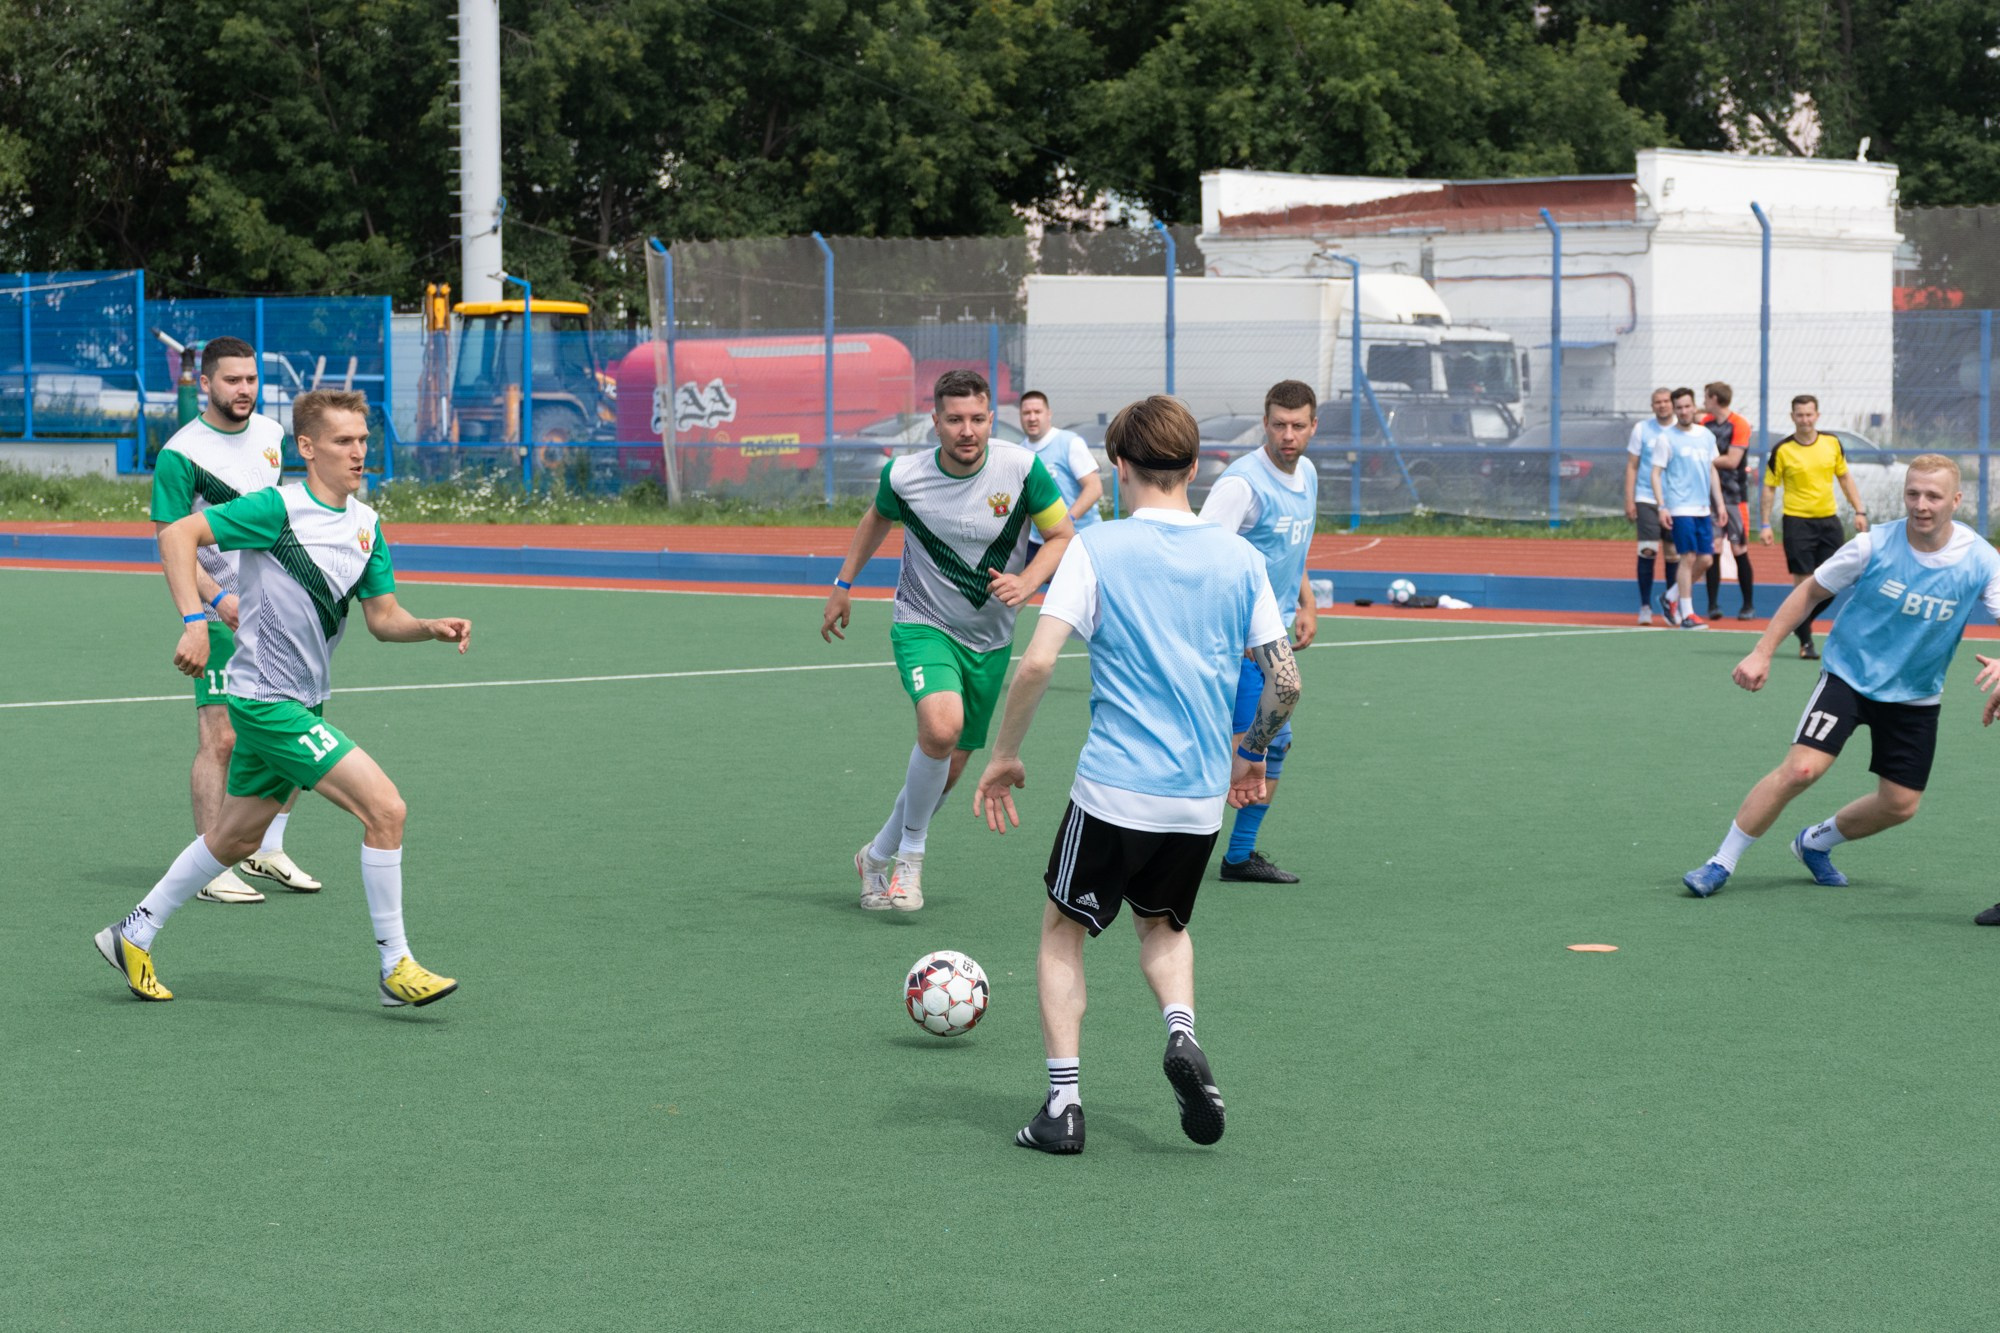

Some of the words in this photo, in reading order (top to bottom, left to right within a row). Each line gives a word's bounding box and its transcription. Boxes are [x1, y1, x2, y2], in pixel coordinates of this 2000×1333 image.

[960, 517, 978, 543] 5
[329, 545, 353, 578] 13
[1901, 592, 1959, 622] ВТБ
[912, 665, 925, 692] 5
[1804, 710, 1839, 742] 17
[298, 724, 339, 762] 13
